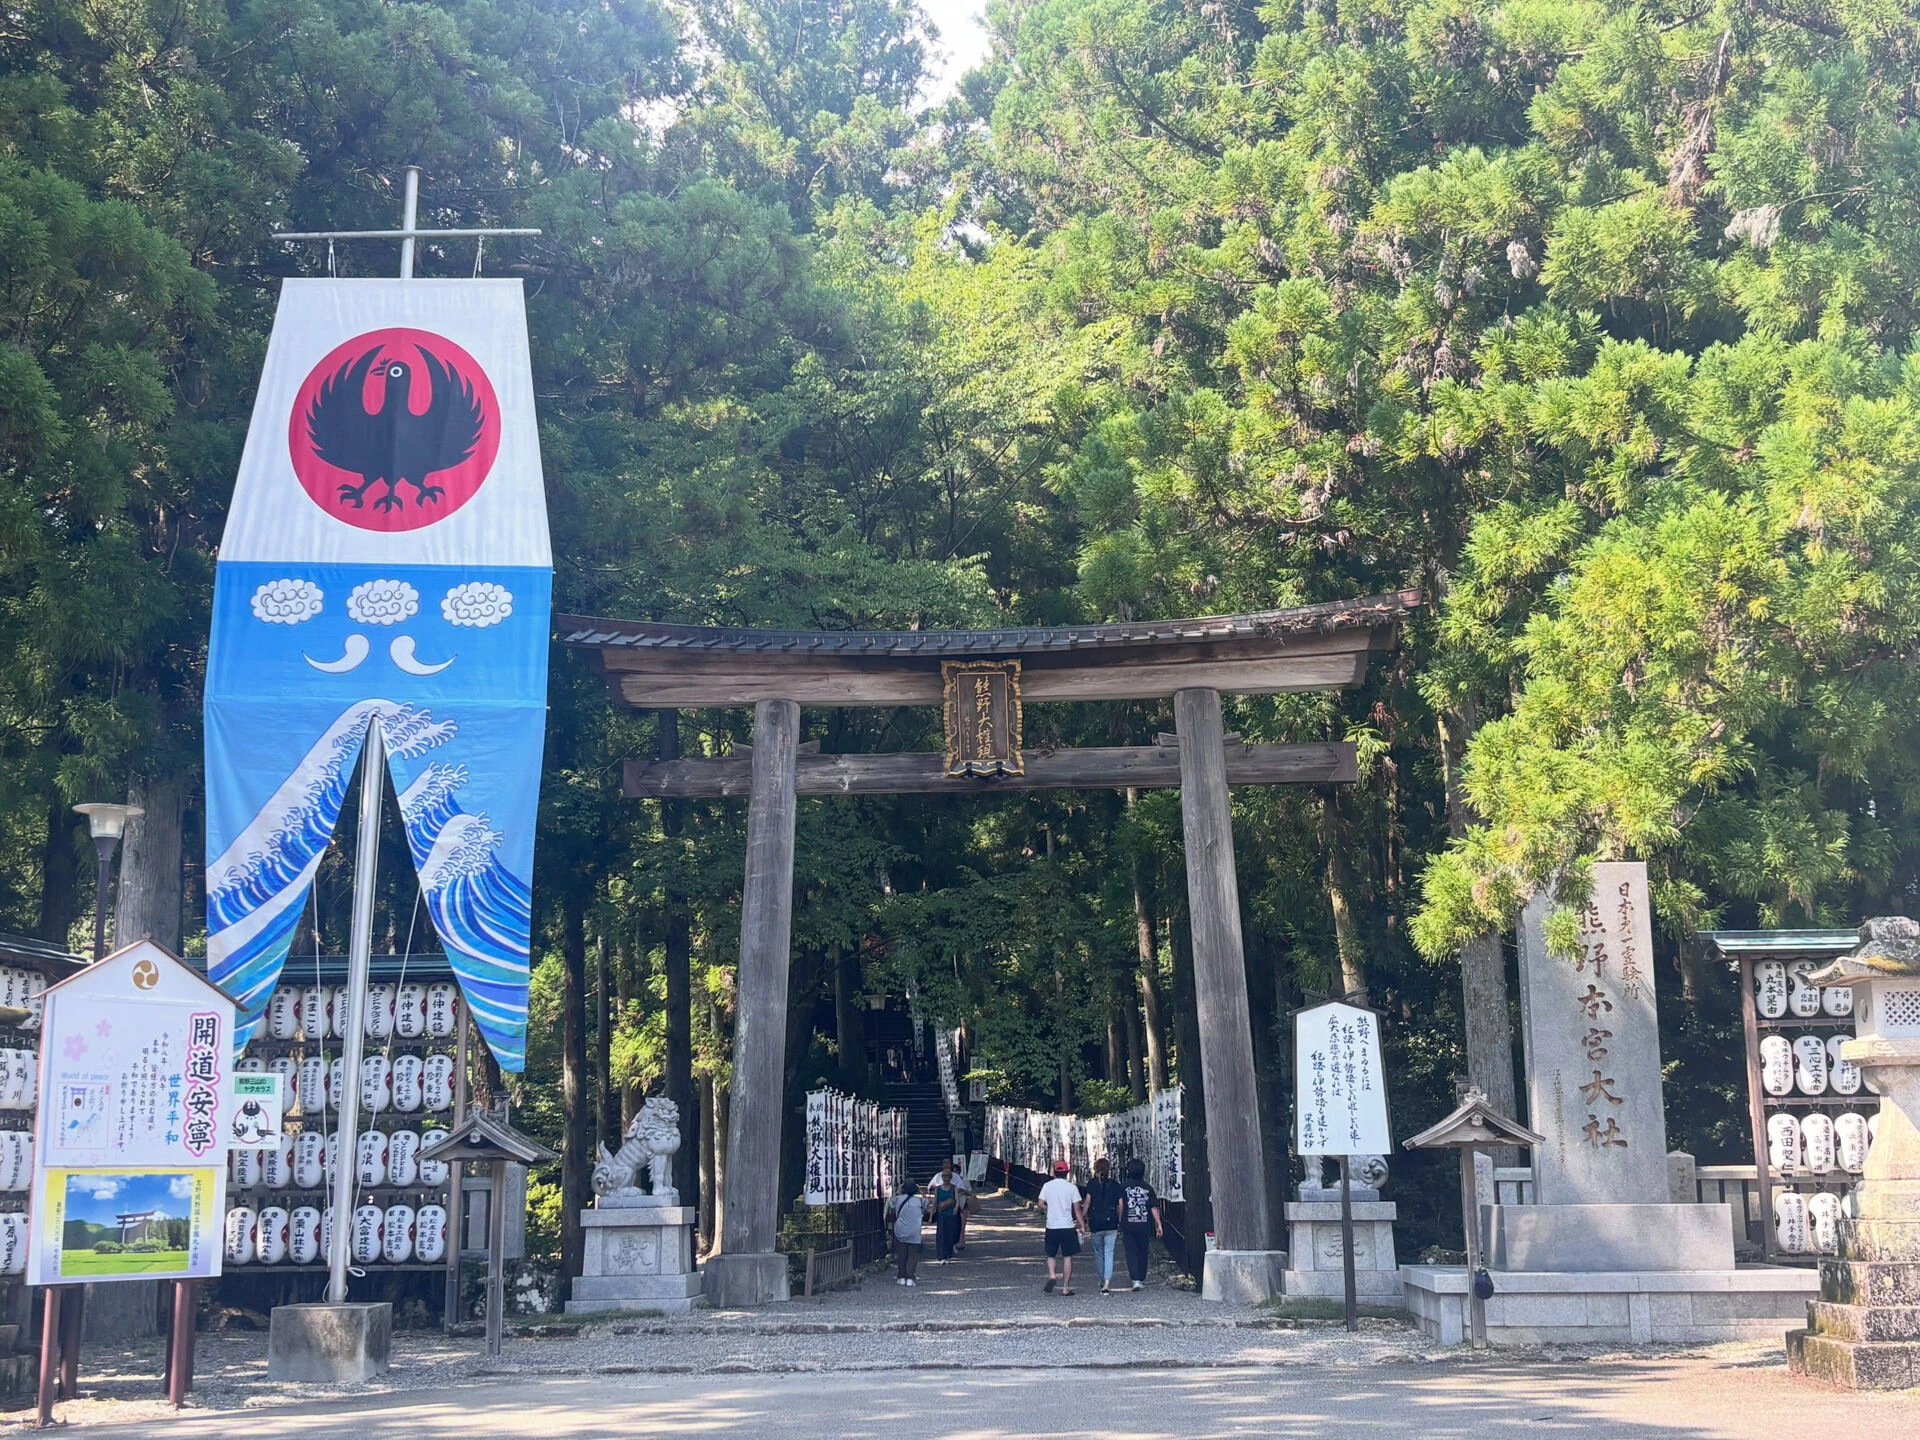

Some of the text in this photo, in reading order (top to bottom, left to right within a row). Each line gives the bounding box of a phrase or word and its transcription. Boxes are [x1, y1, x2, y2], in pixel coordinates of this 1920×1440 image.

[164, 1073, 182, 1146] 世界平和
[187, 1016, 217, 1152] 開道安寧
[243, 1085, 272, 1093] ヤタガラス
